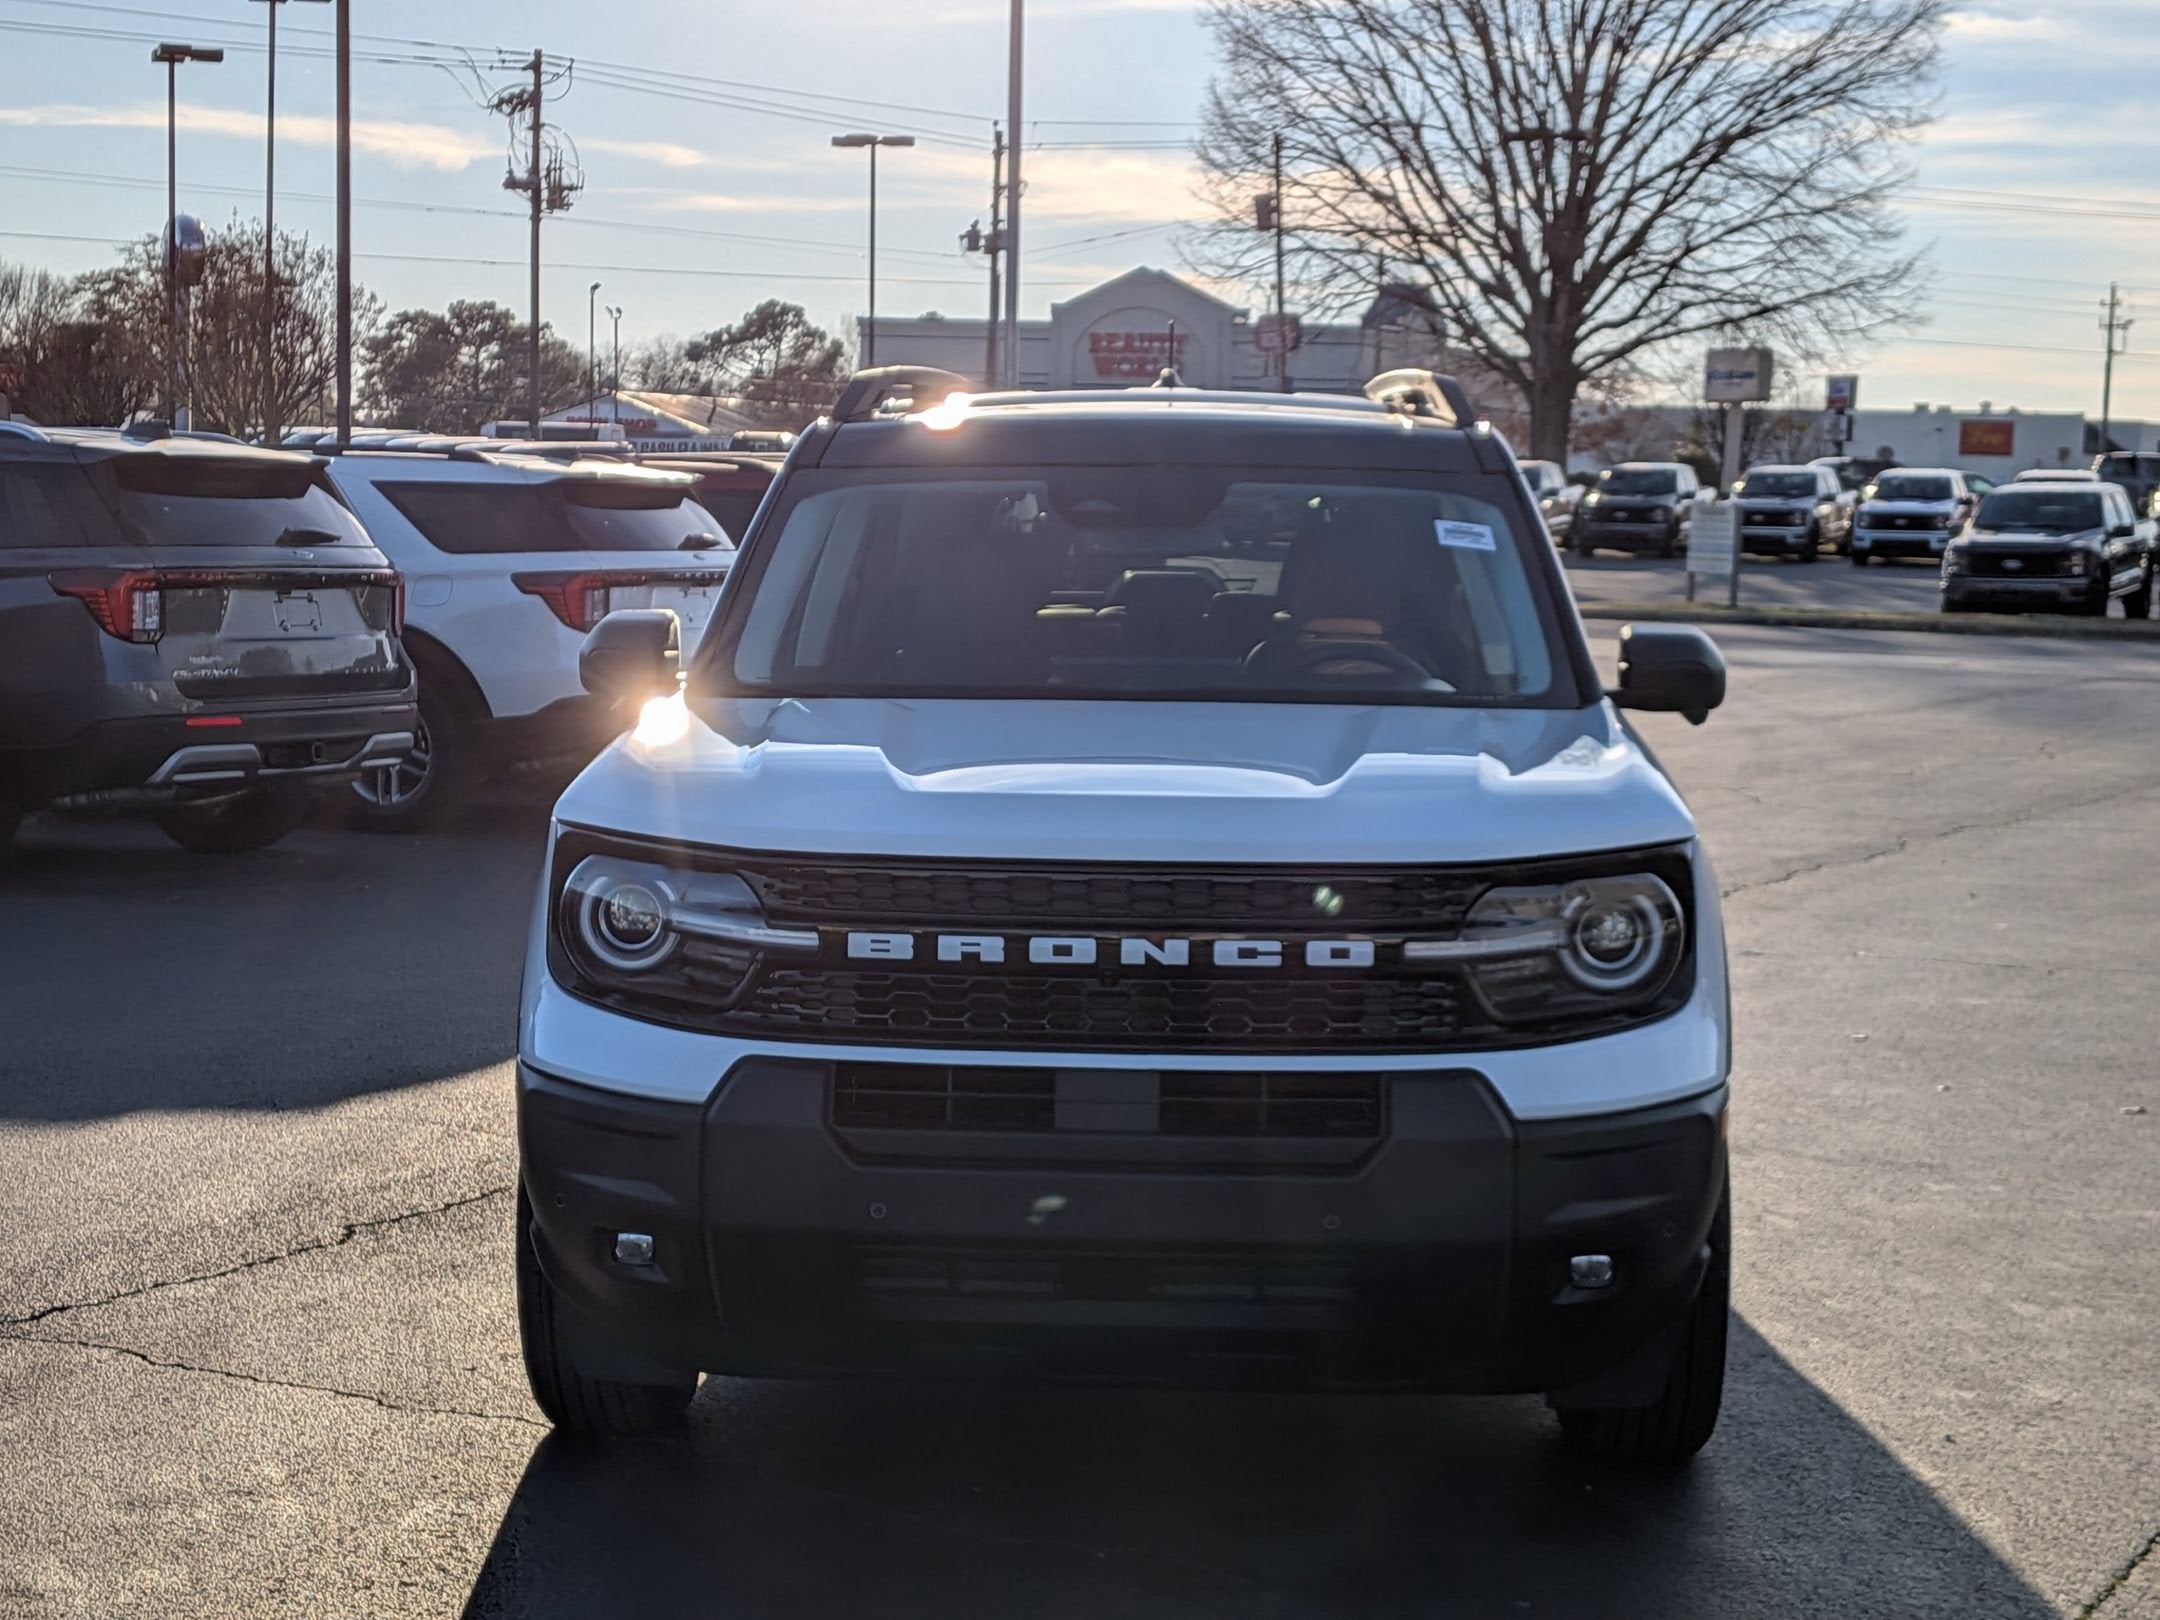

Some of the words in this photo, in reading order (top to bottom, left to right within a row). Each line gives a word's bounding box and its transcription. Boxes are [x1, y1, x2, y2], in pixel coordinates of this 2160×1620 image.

[1088, 332, 1188, 353] BEAUTY
[1094, 354, 1184, 377] WORLD
[846, 931, 1376, 968] BRONCO
